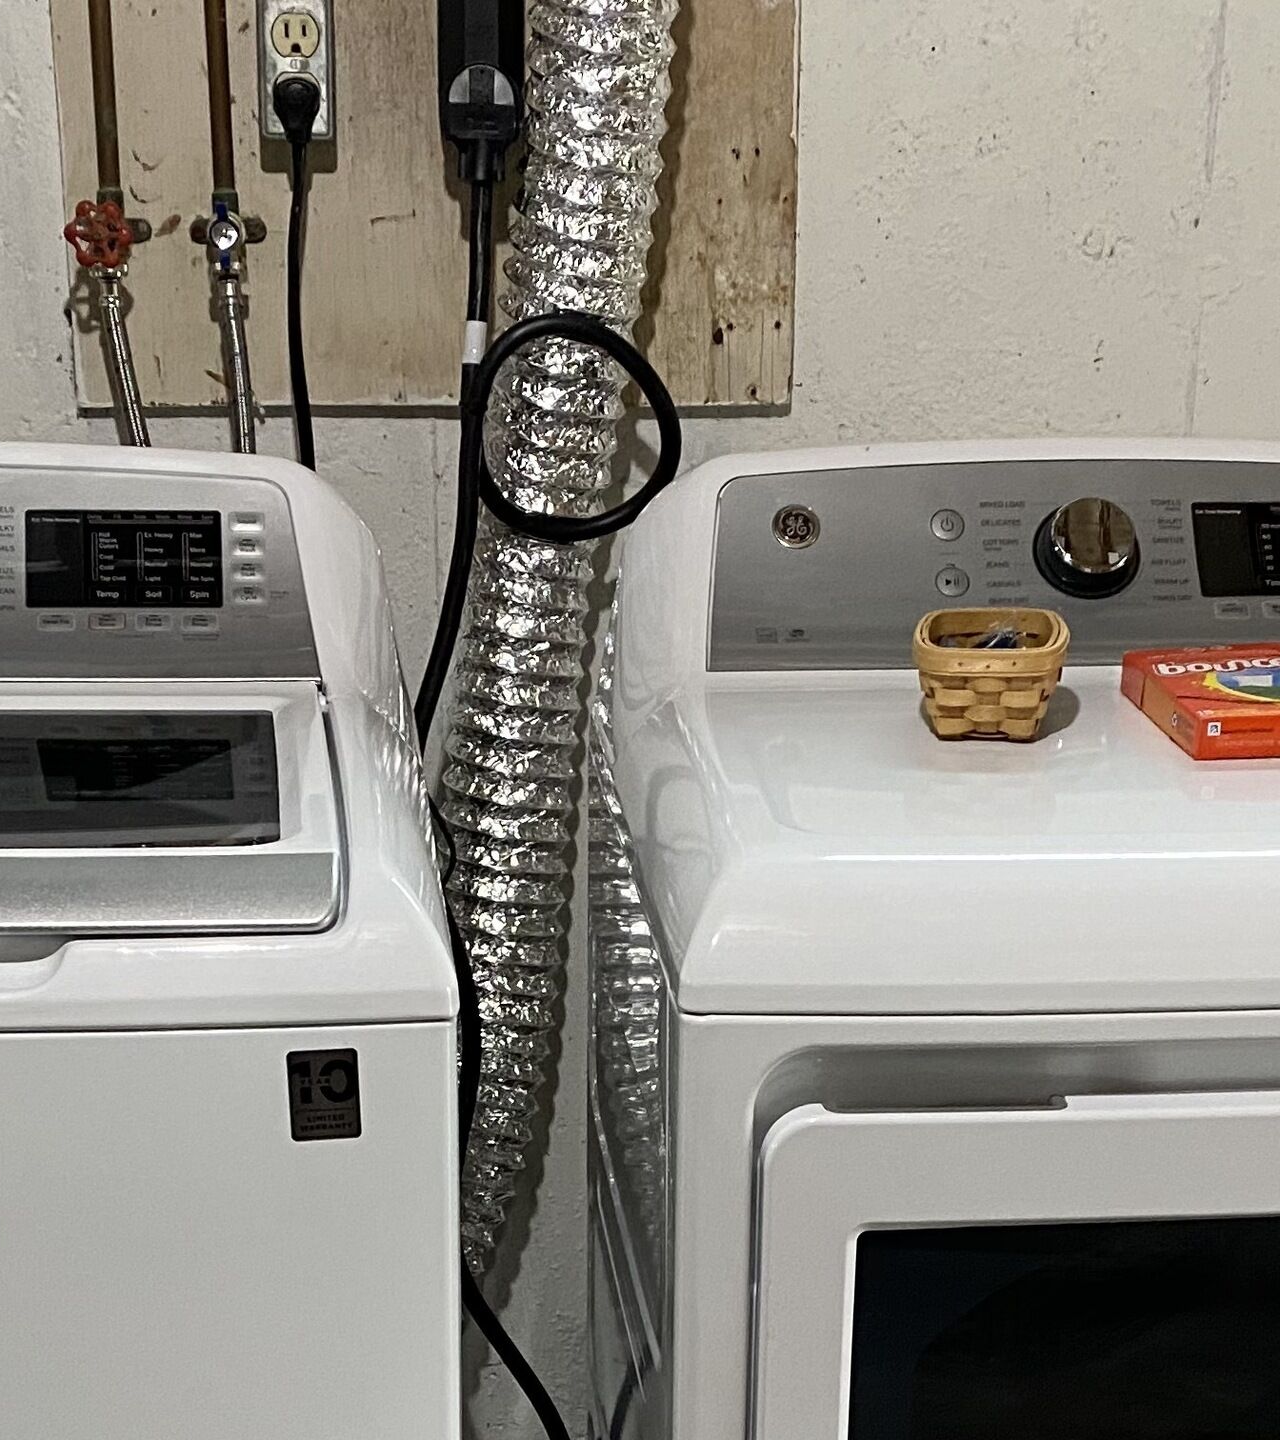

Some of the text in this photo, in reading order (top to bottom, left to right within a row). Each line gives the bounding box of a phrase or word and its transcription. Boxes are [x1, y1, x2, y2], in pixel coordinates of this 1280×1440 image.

[96, 590, 120, 599] Temp
[189, 591, 210, 599] Spin
[289, 1059, 356, 1104] 10
[306, 1113, 346, 1124] LIMITED
[299, 1122, 354, 1133] WARRANTY
